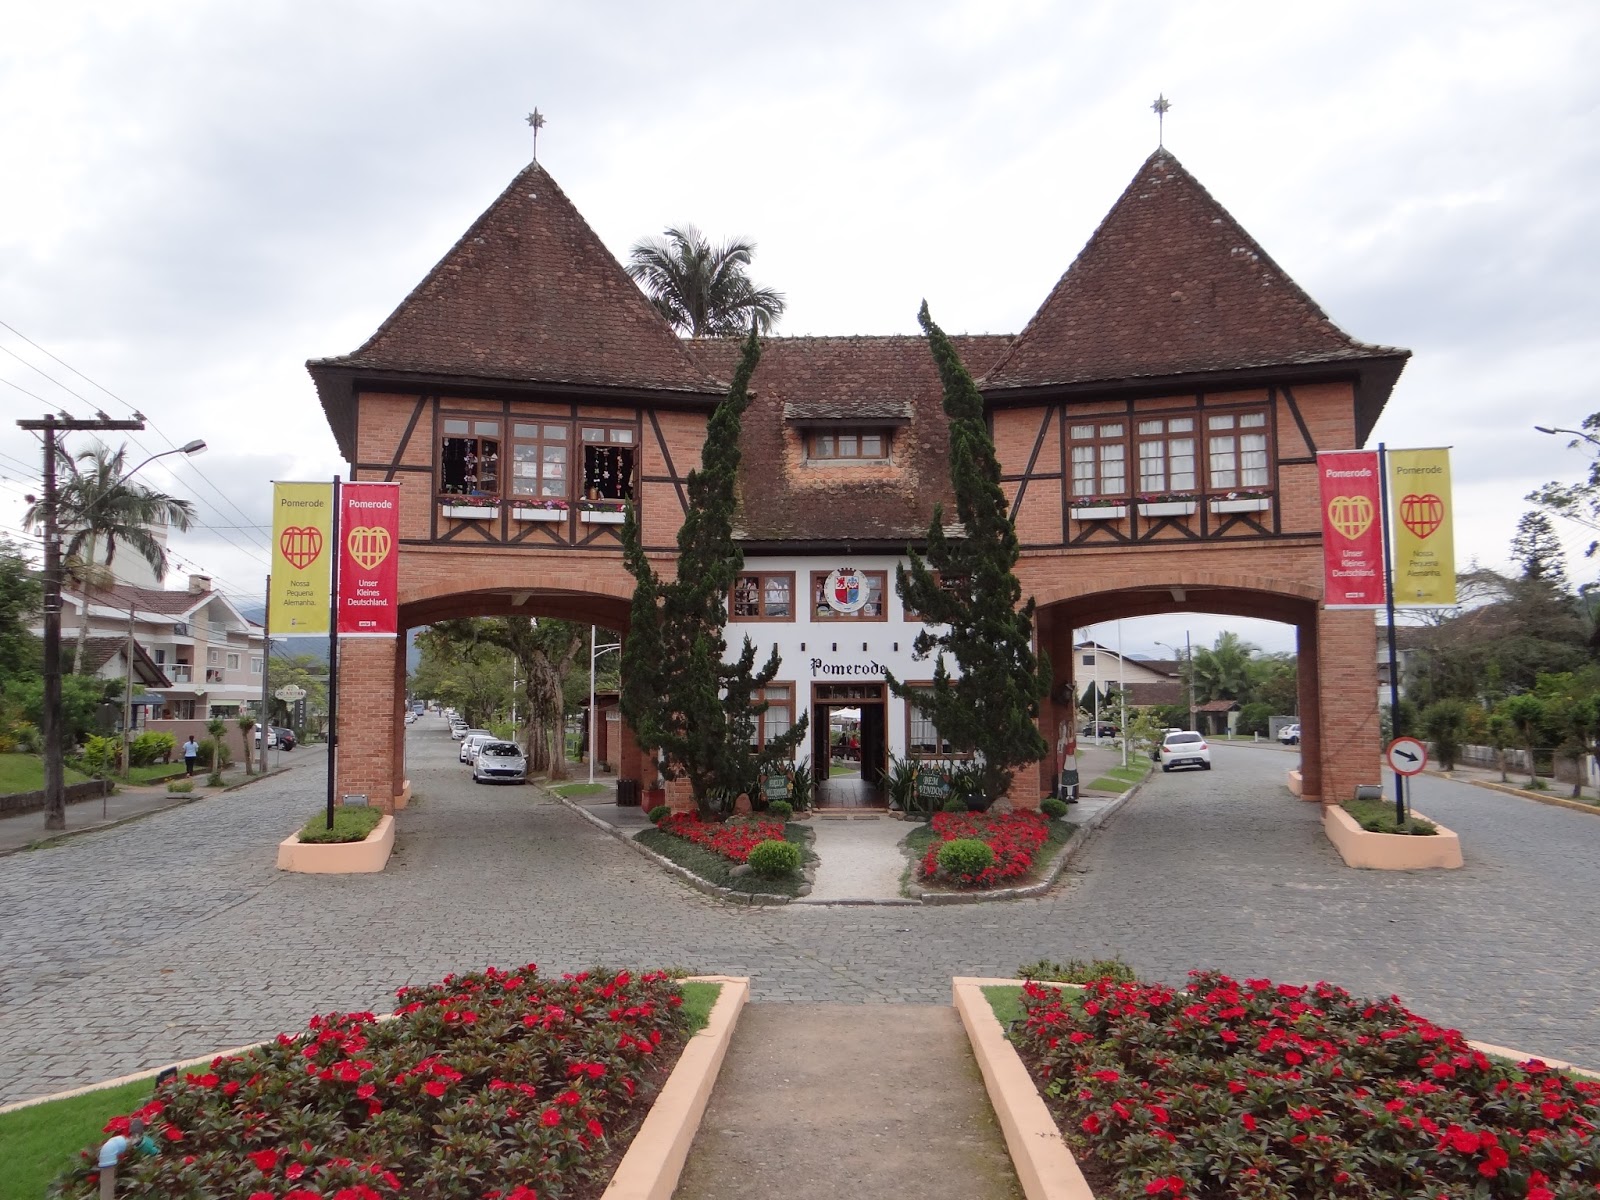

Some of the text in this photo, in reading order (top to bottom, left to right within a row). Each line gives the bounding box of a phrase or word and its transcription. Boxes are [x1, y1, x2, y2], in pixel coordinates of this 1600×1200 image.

[1326, 468, 1372, 478] Pomerode
[1396, 466, 1442, 475] Pomerode
[281, 499, 324, 508] Pomerode
[349, 500, 392, 508] Pomerode
[1409, 560, 1438, 568] Pequena
[1332, 569, 1376, 577] Deutschland.
[348, 598, 388, 606] Deutschland.
[810, 658, 887, 677] Pomerode
[922, 776, 939, 785] BEM
